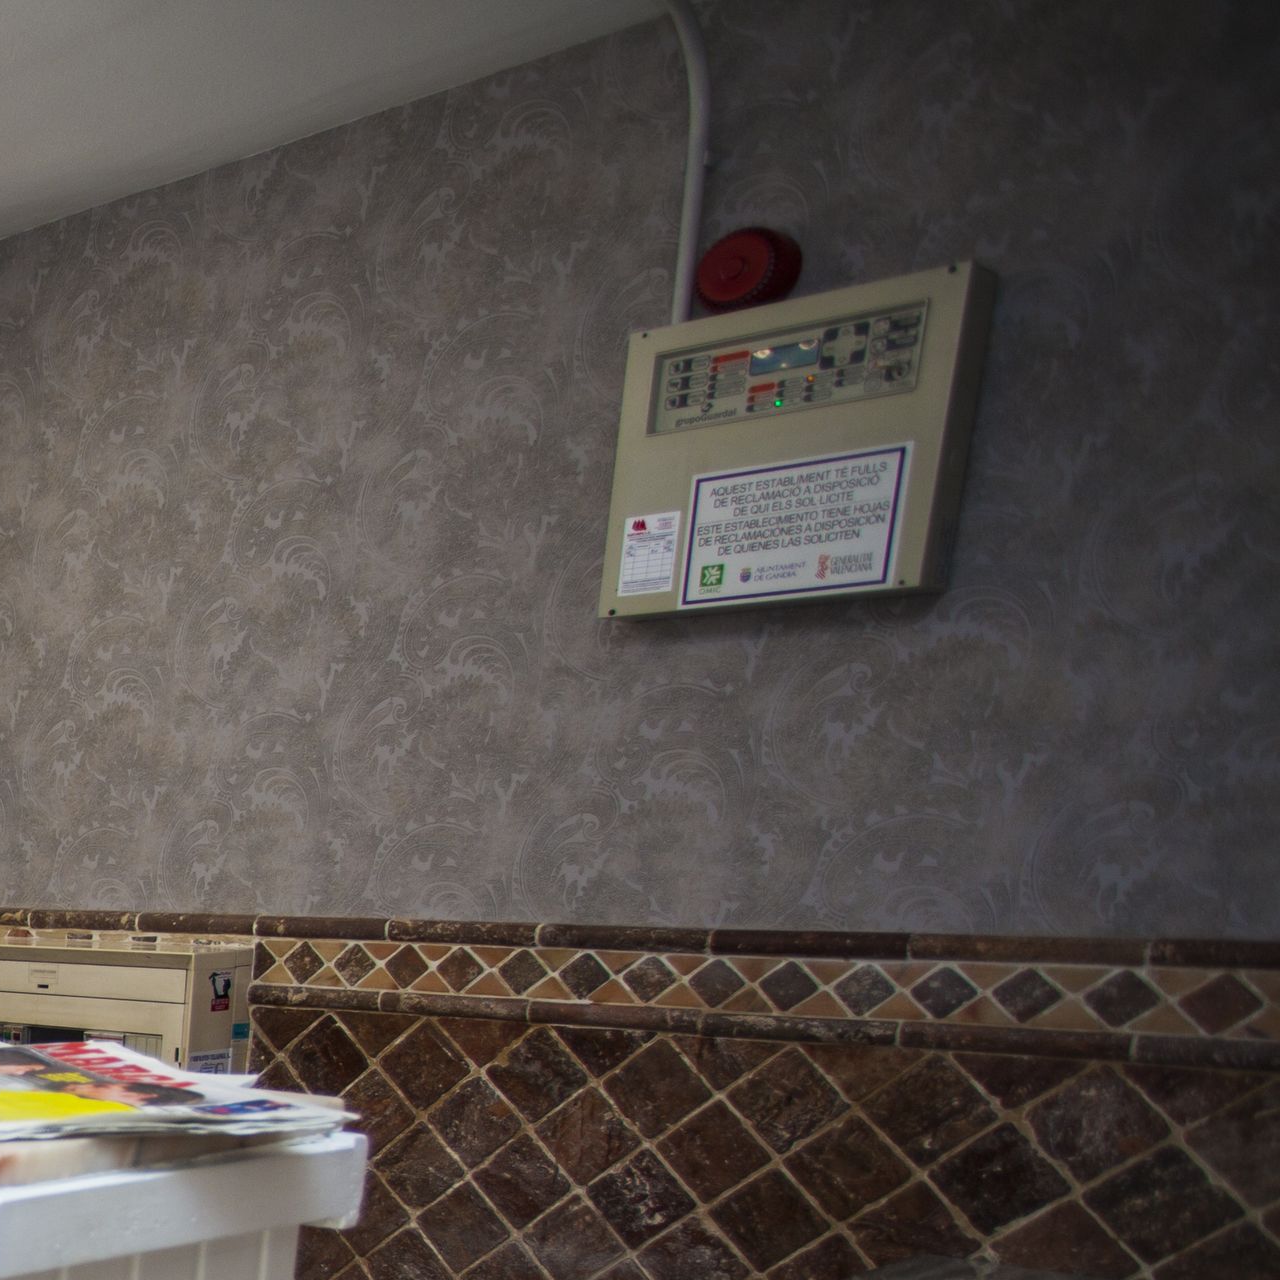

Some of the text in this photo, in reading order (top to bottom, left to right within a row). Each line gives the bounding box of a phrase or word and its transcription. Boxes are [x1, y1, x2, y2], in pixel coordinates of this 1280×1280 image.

[710, 481, 754, 497] AQUEST
[755, 470, 831, 491] ESTABLIMENT
[851, 462, 887, 477] FULLS
[713, 498, 729, 509] DE
[803, 485, 812, 496] A
[733, 506, 748, 517] DE
[750, 504, 769, 515] QUI
[771, 500, 792, 512] ELS
[697, 500, 890, 537] ESTE ESTABLECIMIENTO TIENE HOJAS
[698, 537, 713, 548] DE
[713, 524, 803, 545] RECLAMACIONES
[804, 524, 812, 534] A
[717, 529, 860, 556] DE QUIENES LAS SOLICITEN
